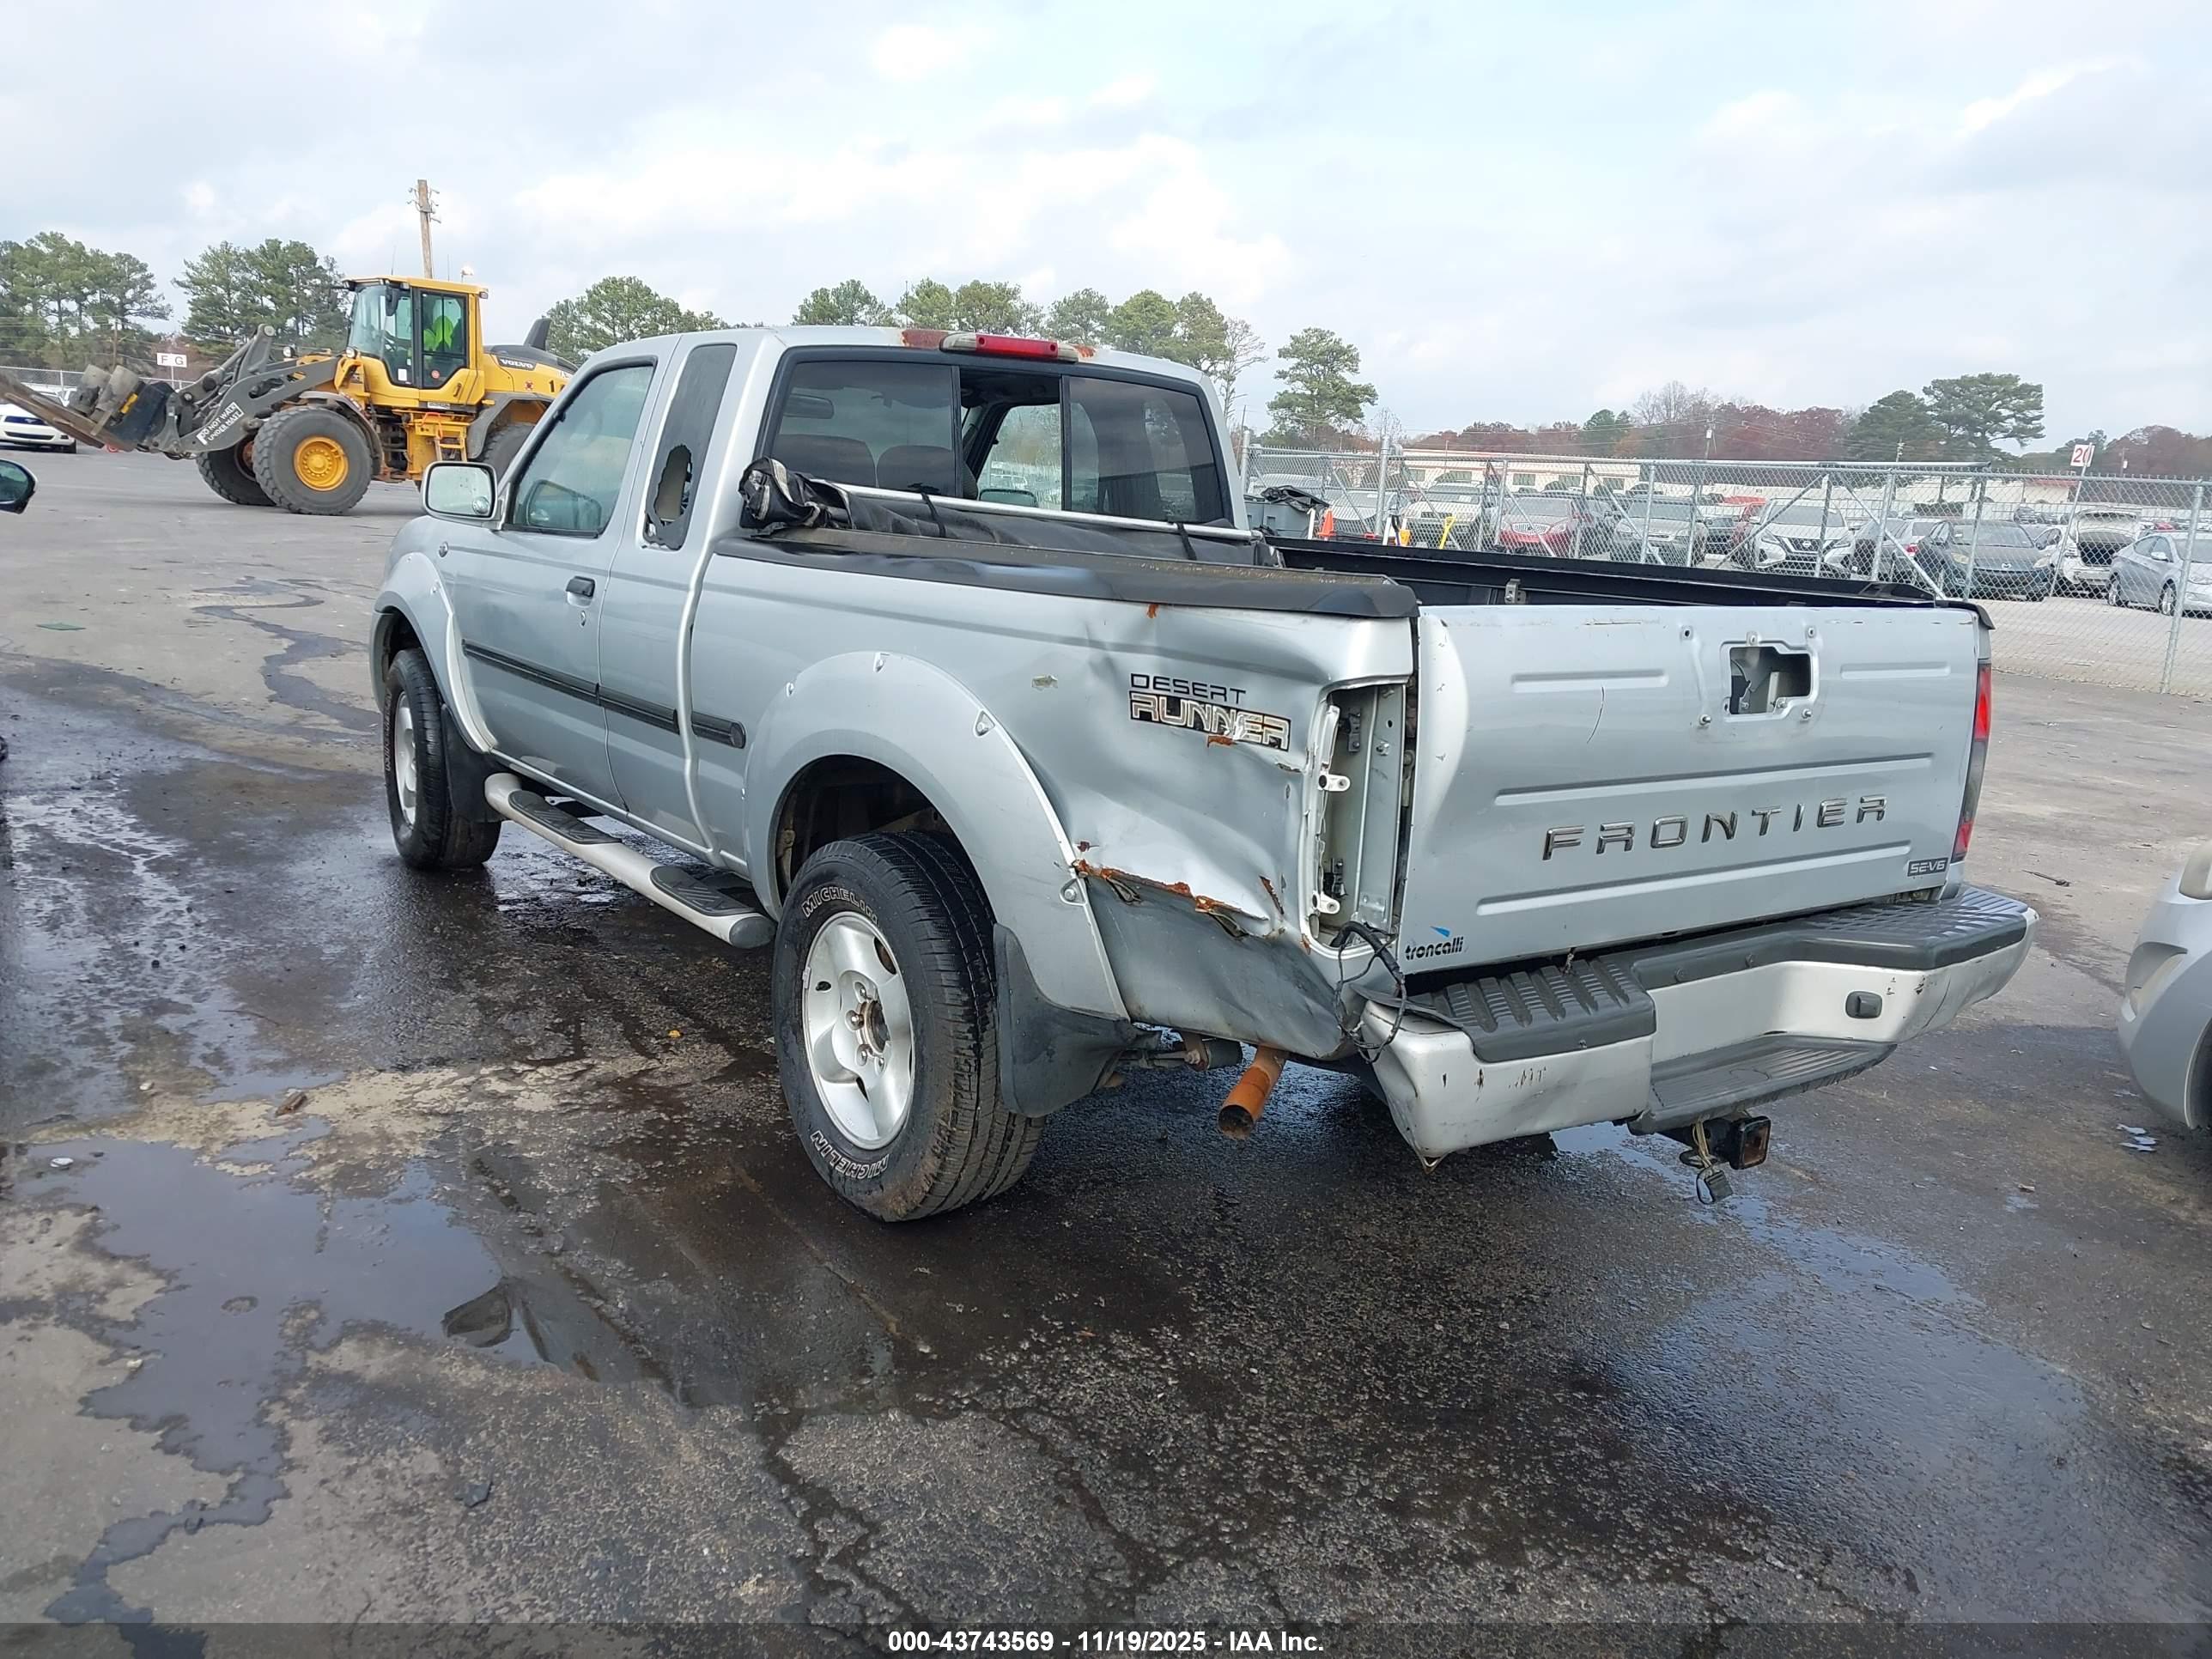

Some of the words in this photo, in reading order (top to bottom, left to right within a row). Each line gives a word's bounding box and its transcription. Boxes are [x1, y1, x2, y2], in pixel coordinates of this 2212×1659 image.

[161, 355, 169, 364] F
[174, 356, 184, 365] G
[500, 359, 534, 368] VOLVO
[208, 417, 222, 431] NOT
[219, 403, 237, 420] WALK
[208, 424, 229, 441] UNDER
[2073, 447, 2093, 464] 20
[1131, 673, 1246, 704] DESERT
[1129, 690, 1291, 752] RUNNER
[1542, 793, 1888, 861] FRONTIER
[801, 886, 879, 927] MICHELIN
[1405, 936, 1464, 961] troncalli
[810, 1130, 890, 1180] MICHELIN
